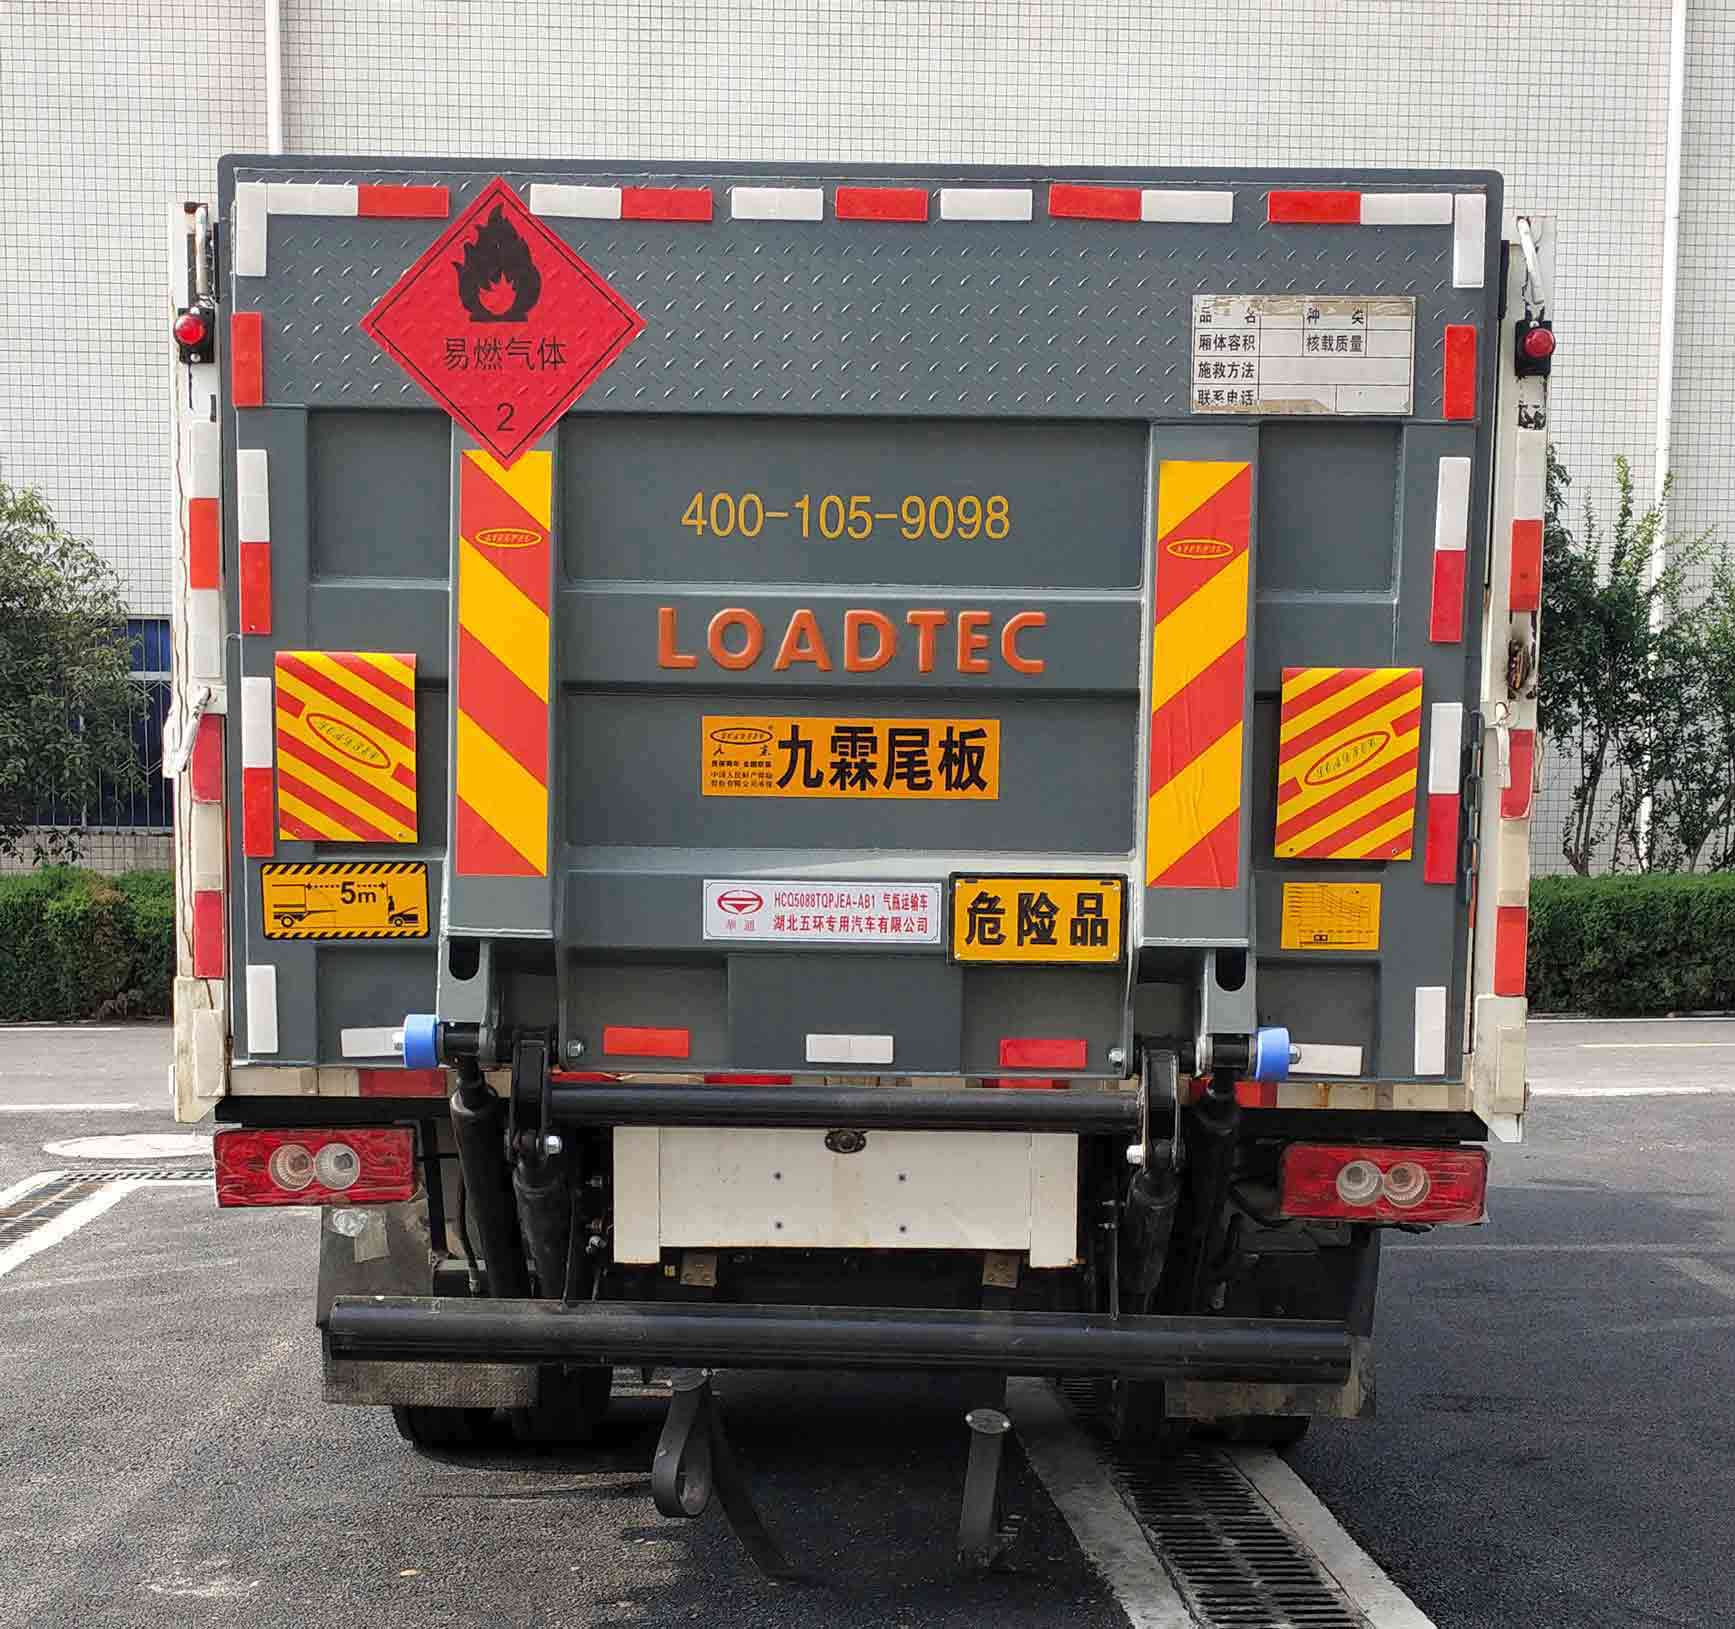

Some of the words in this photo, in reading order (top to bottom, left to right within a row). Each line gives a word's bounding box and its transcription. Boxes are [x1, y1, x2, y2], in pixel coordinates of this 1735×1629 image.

[442, 336, 567, 371] 易燃气体
[1198, 333, 1256, 352] 厢体容积
[1305, 334, 1364, 353] 核载质量
[1197, 360, 1255, 379] 施救方法
[1197, 389, 1255, 406] 联系电话
[495, 402, 516, 432] 2
[680, 491, 1011, 541] 400-105-9098
[657, 607, 1047, 674] LOADTEC
[776, 724, 988, 792] 九霖尾板
[340, 881, 377, 905] 5m
[883, 892, 929, 913] 气瓶运输车
[772, 914, 929, 934] 湖北五环专用汽车有限公司
[964, 891, 1110, 947] 危险品
